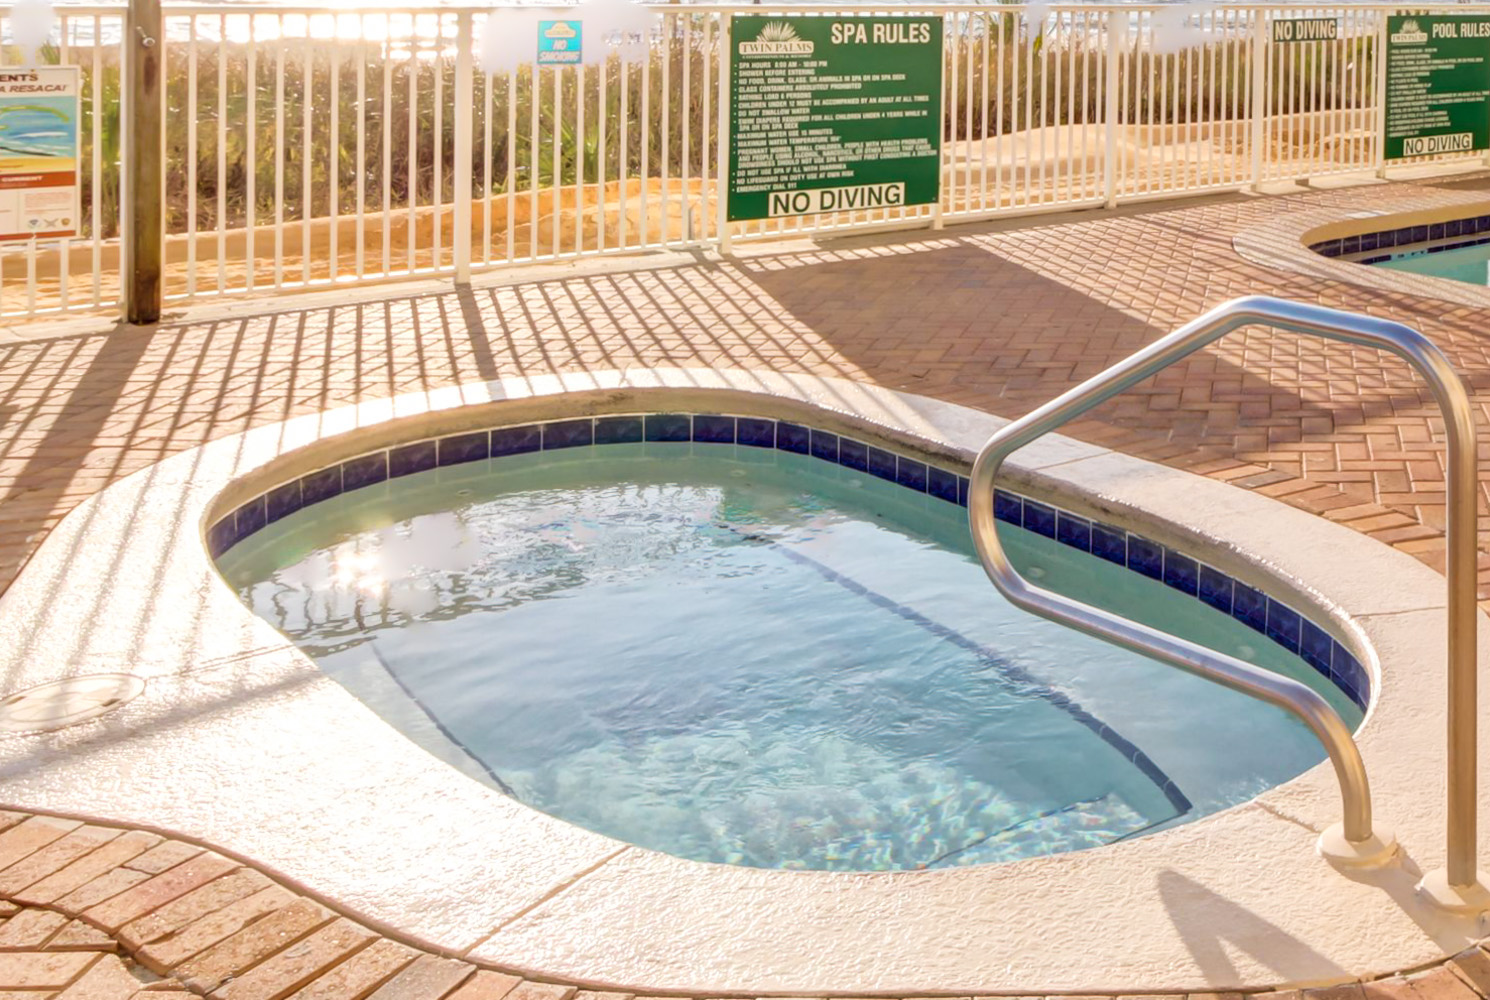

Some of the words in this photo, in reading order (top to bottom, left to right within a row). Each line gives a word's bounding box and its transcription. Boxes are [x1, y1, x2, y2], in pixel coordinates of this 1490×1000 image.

[831, 24, 868, 44] SPA
[873, 23, 931, 44] RULES
[1275, 21, 1293, 40] NO
[1296, 20, 1336, 40] DIVING
[1432, 23, 1458, 38] POOL
[1460, 22, 1490, 37] RULES
[553, 39, 568, 51] NO
[742, 44, 772, 52] TWIN
[775, 43, 812, 52] PALMS
[538, 51, 580, 62] SMOKING
[8, 84, 67, 93] RESACA!
[1405, 139, 1424, 154] NO
[1428, 134, 1470, 152] DIVING
[773, 191, 810, 215] NO
[820, 184, 901, 210] DIVING
